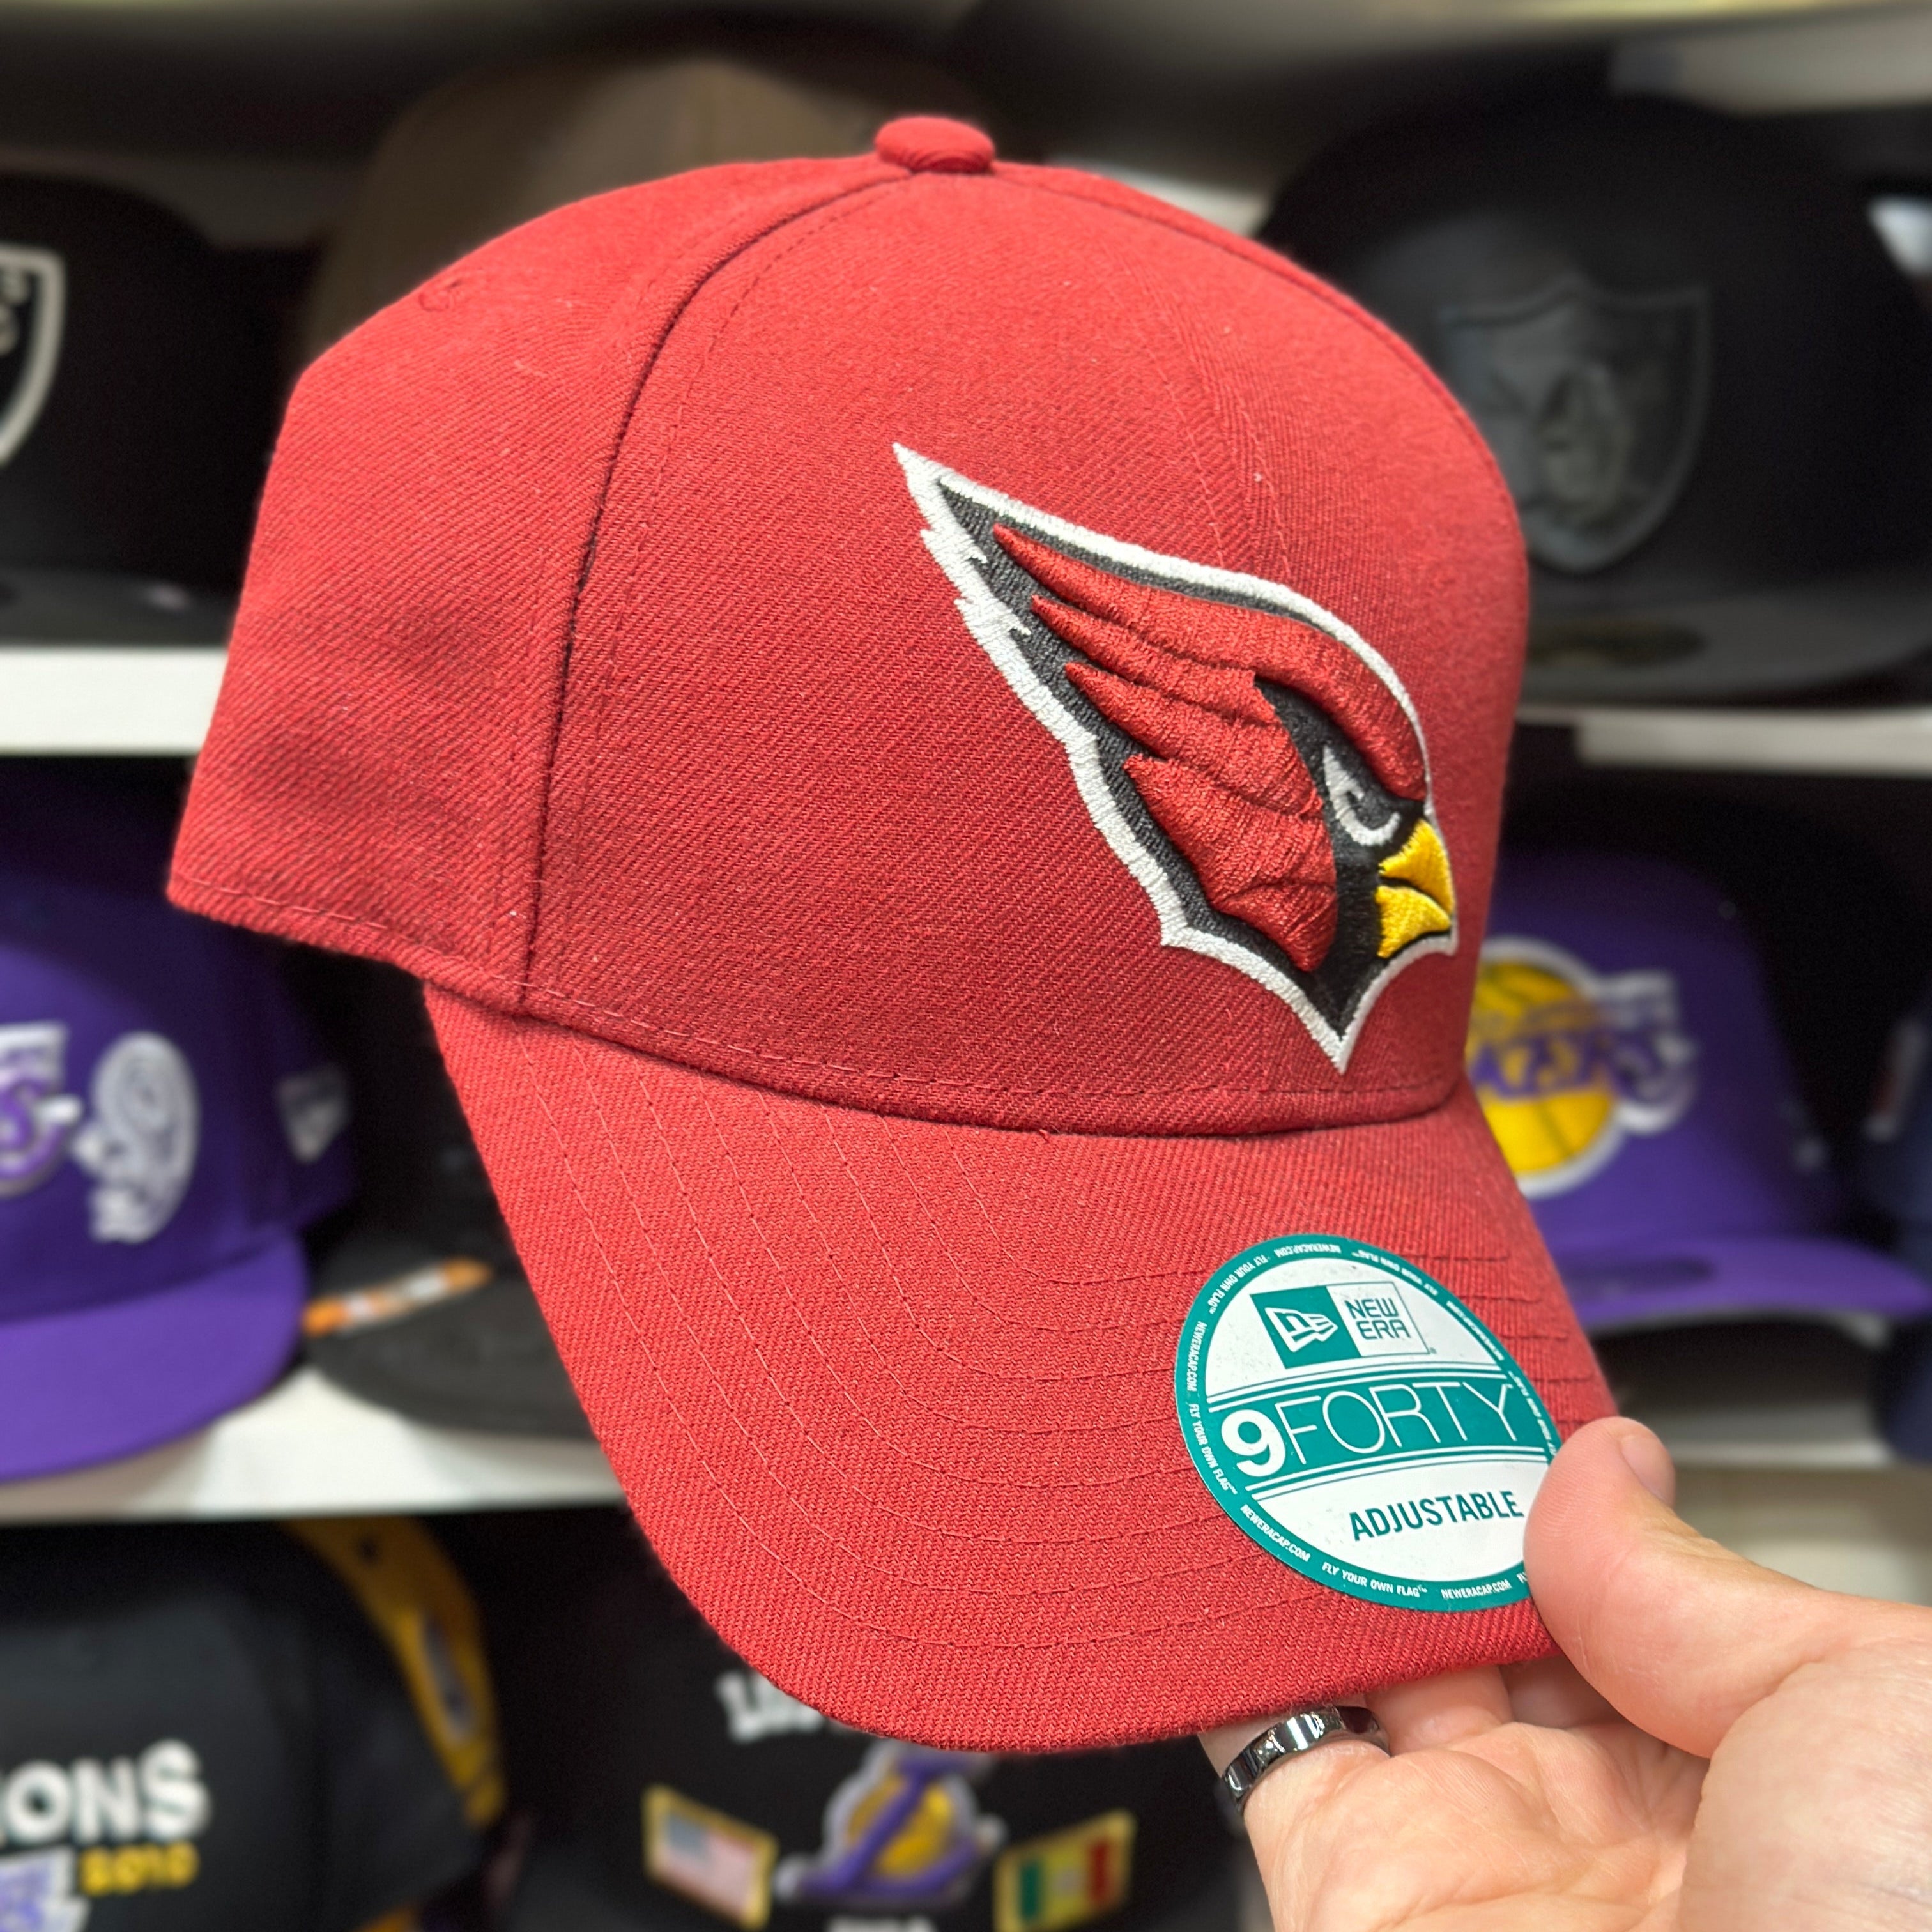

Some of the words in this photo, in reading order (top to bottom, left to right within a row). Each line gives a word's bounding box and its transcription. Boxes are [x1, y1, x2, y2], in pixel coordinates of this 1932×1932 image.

[1254, 1254, 1269, 1266] FLY
[1274, 1243, 1341, 1258] NEWERACAP.COM
[1235, 1261, 1255, 1278] YOUR
[1220, 1274, 1238, 1292] OWN
[1344, 1298, 1399, 1319] NEW
[1356, 1319, 1412, 1340] ERA
[1186, 1321, 1208, 1392] NEWERACAP.COM
[1188, 1404, 1200, 1418] FLY
[1192, 1420, 1208, 1445] YOUR
[1221, 1382, 1518, 1477] 9FORTY
[1201, 1446, 1219, 1468] OWN
[1349, 1491, 1525, 1542] ADJUSTABLE
[1240, 1504, 1311, 1562] NEWERACAP.COM
[1322, 1561, 1340, 1576] FLY
[1342, 1570, 1367, 1587] YOUR
[1370, 1579, 1393, 1593] OWN
[1441, 1579, 1512, 1599] NEWERACAP.COM
[0, 1738, 211, 1848] ONS
